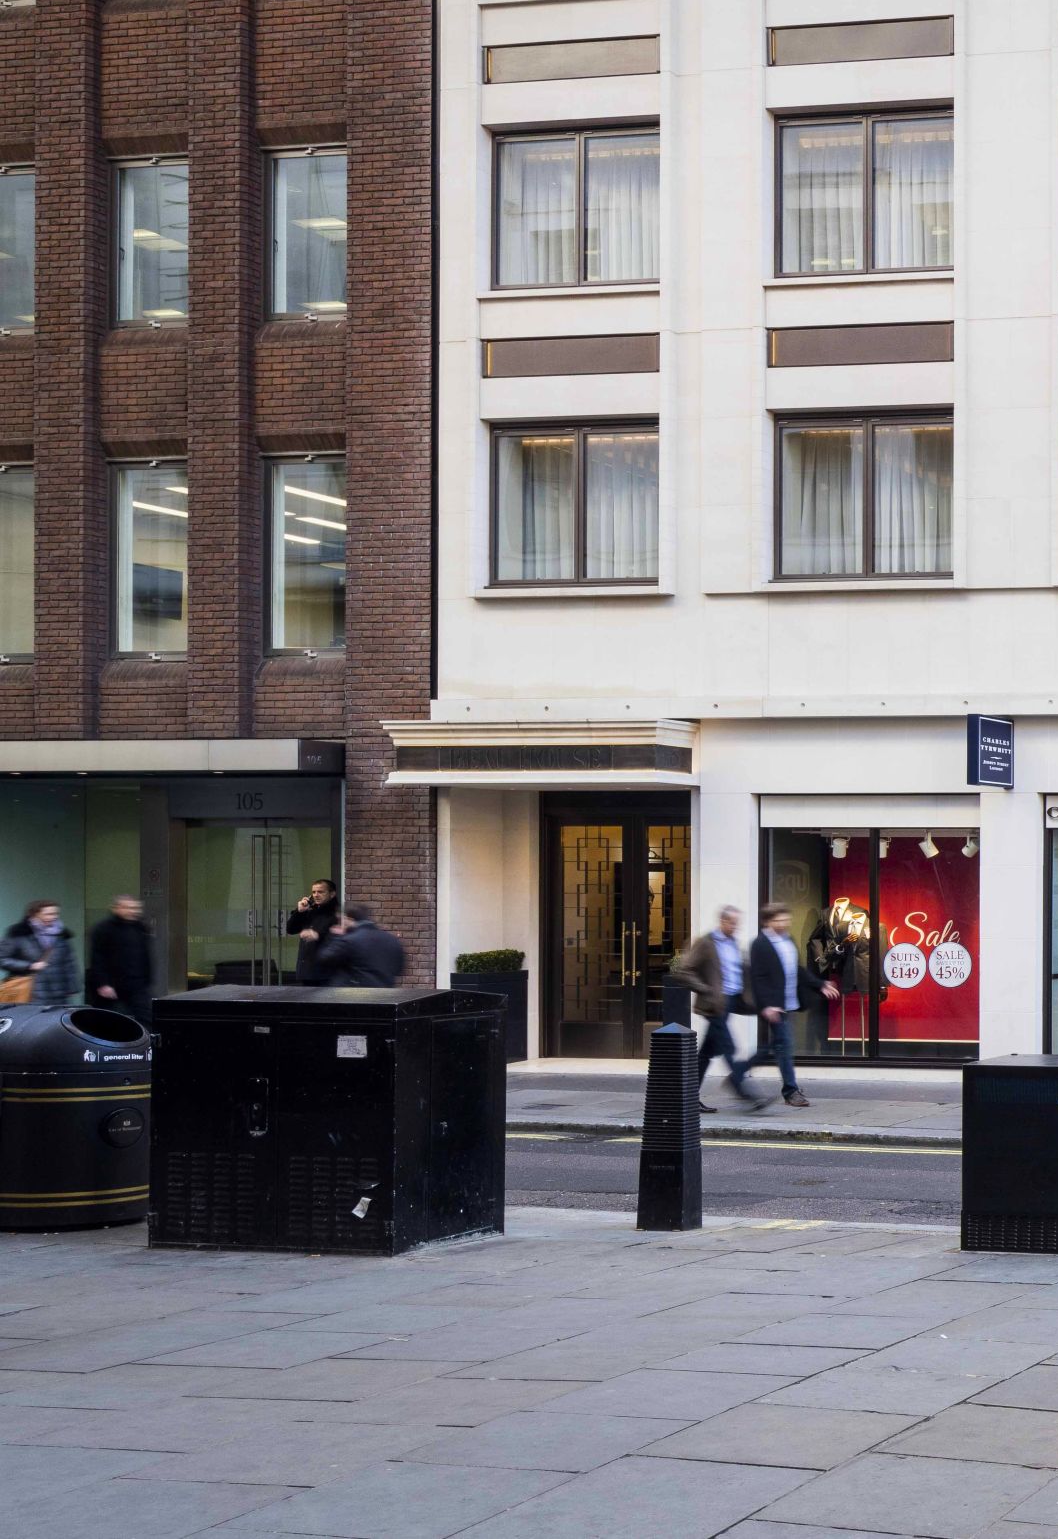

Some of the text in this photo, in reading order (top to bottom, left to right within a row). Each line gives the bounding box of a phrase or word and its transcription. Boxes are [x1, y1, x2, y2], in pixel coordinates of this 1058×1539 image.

[982, 736, 1010, 746] CHARLES
[980, 745, 1011, 754] TYRWHITT
[235, 792, 263, 810] 105
[889, 911, 960, 947] Sale
[890, 952, 920, 961] SUITS
[936, 950, 964, 960] SALE
[891, 967, 920, 979] £149
[935, 966, 965, 979] 45%
[103, 1053, 131, 1062] general
